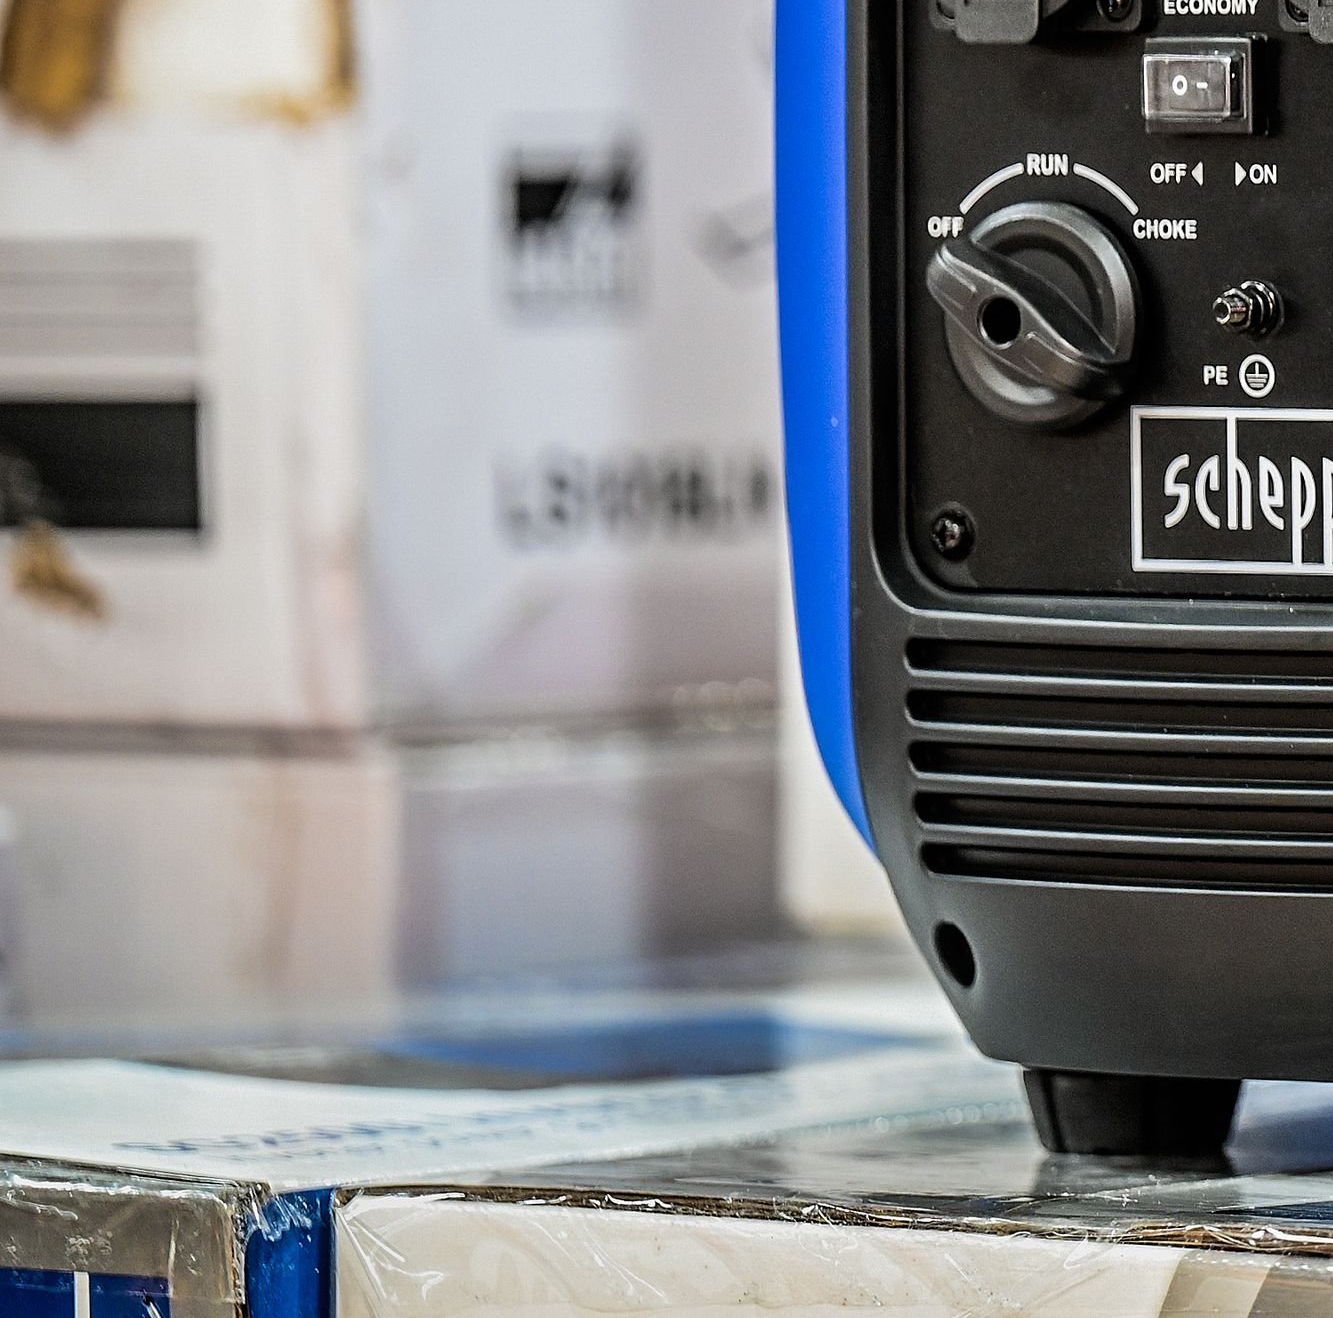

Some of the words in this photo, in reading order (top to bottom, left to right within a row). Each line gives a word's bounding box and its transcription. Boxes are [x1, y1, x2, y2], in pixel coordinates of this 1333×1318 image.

[1026, 153, 1069, 176] RUN
[1149, 162, 1188, 184] OFF
[1249, 163, 1277, 185] ON
[927, 216, 964, 238] OFF
[1132, 218, 1198, 240] CHOKE
[1203, 365, 1229, 386] PE
